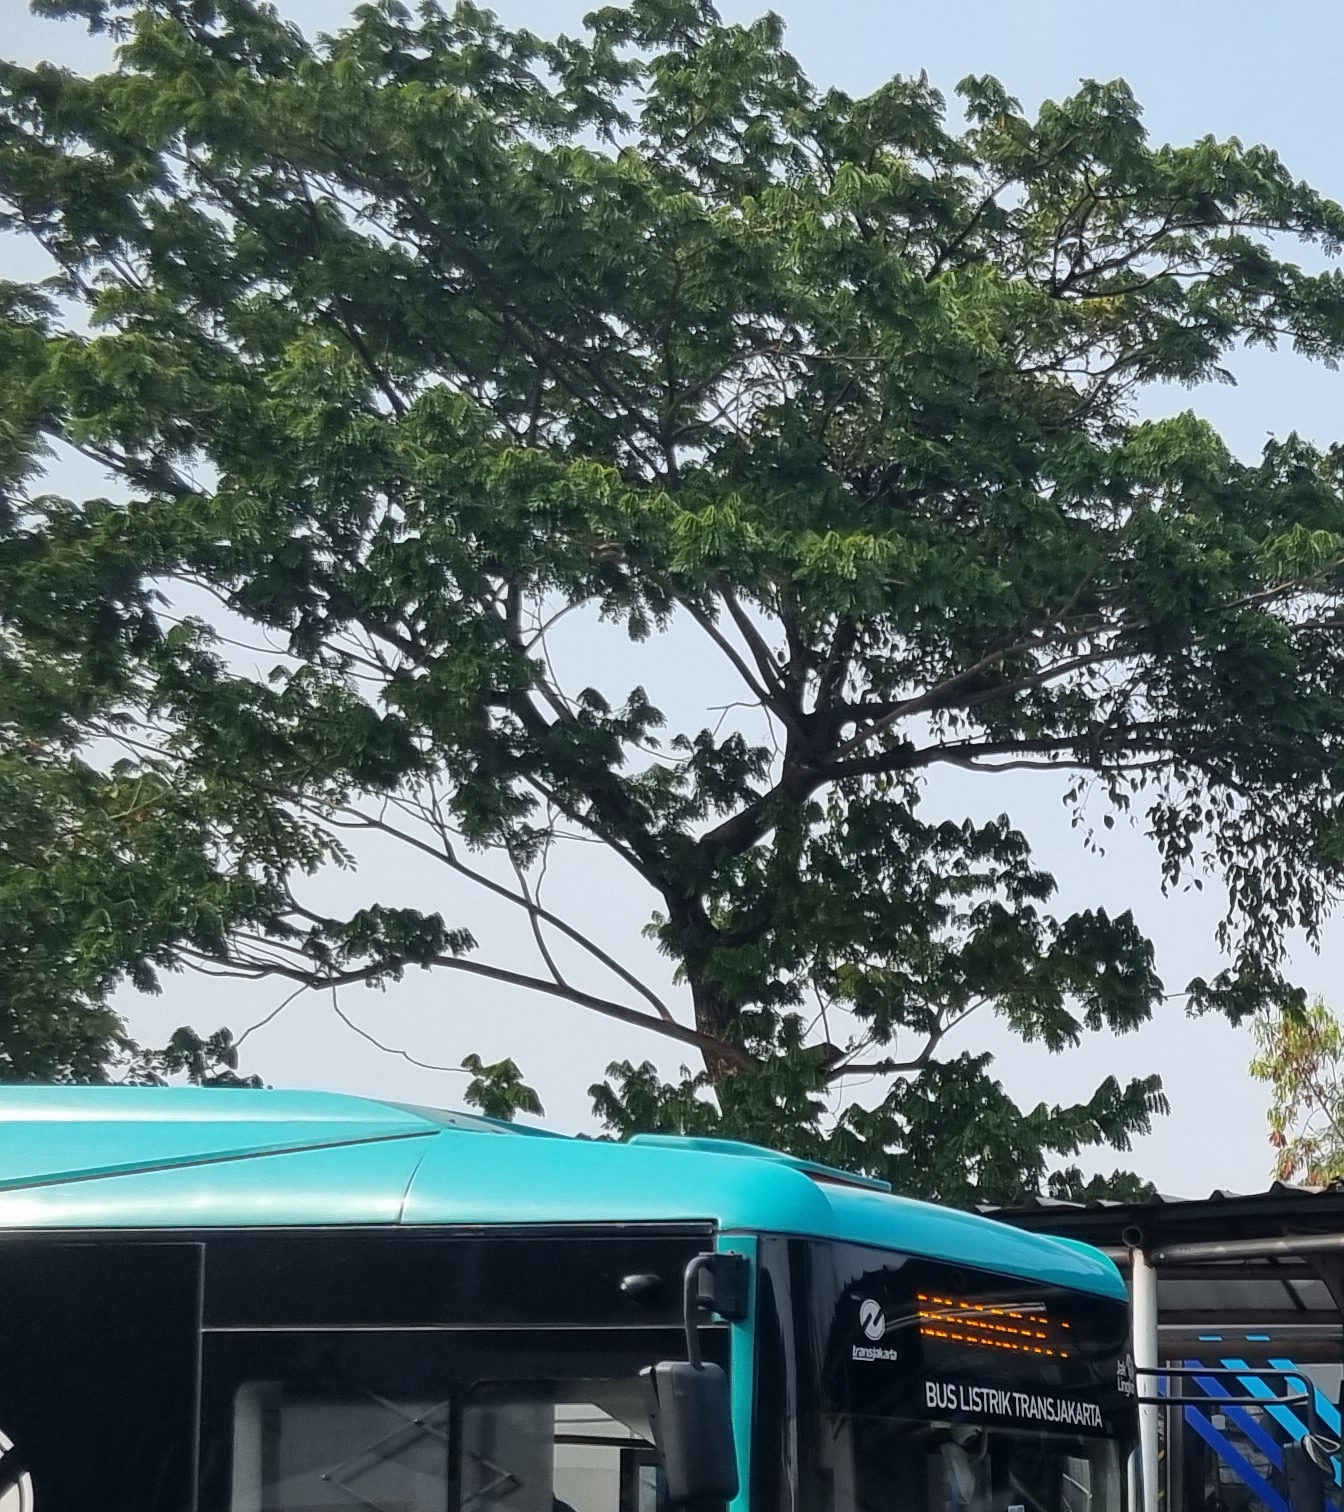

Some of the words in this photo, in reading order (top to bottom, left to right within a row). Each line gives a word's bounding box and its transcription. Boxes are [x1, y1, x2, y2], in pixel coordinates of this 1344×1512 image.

[925, 1381, 958, 1411] BUS
[959, 1385, 1012, 1417] LISTRIK
[1012, 1392, 1103, 1428] TRANSJAKARTA
